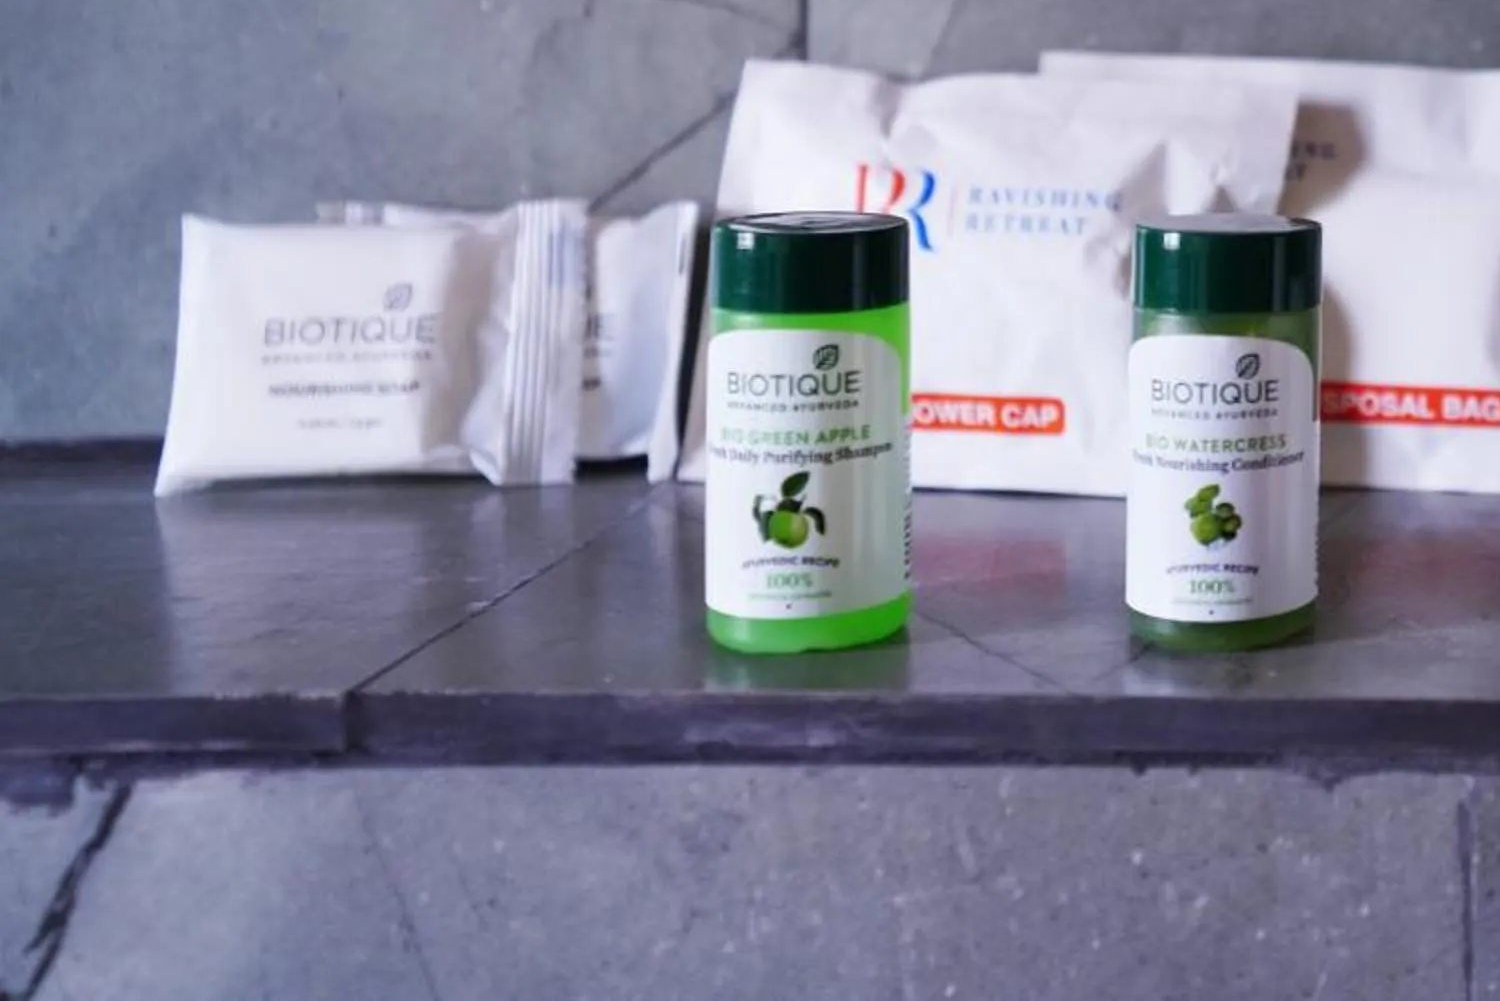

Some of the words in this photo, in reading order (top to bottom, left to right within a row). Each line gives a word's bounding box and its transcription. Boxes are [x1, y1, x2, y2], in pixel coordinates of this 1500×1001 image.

[967, 185, 1124, 212] RAVISHING
[965, 211, 1087, 236] RETREAT
[264, 314, 438, 345] BIOTIQUE
[727, 370, 861, 398] BIOTIQUE
[1151, 378, 1280, 405] BIOTIQUE
[914, 399, 995, 426] OWER
[1001, 402, 1060, 429] CAP
[1322, 391, 1435, 419] SPOSAL
[750, 428, 810, 445] GREEN
[814, 424, 872, 444] APPLE
[1172, 432, 1287, 453] WATERCRESS
[763, 449, 833, 468] Purifying
[1156, 455, 1230, 474] Nourishing
[1189, 579, 1236, 595] 100%
